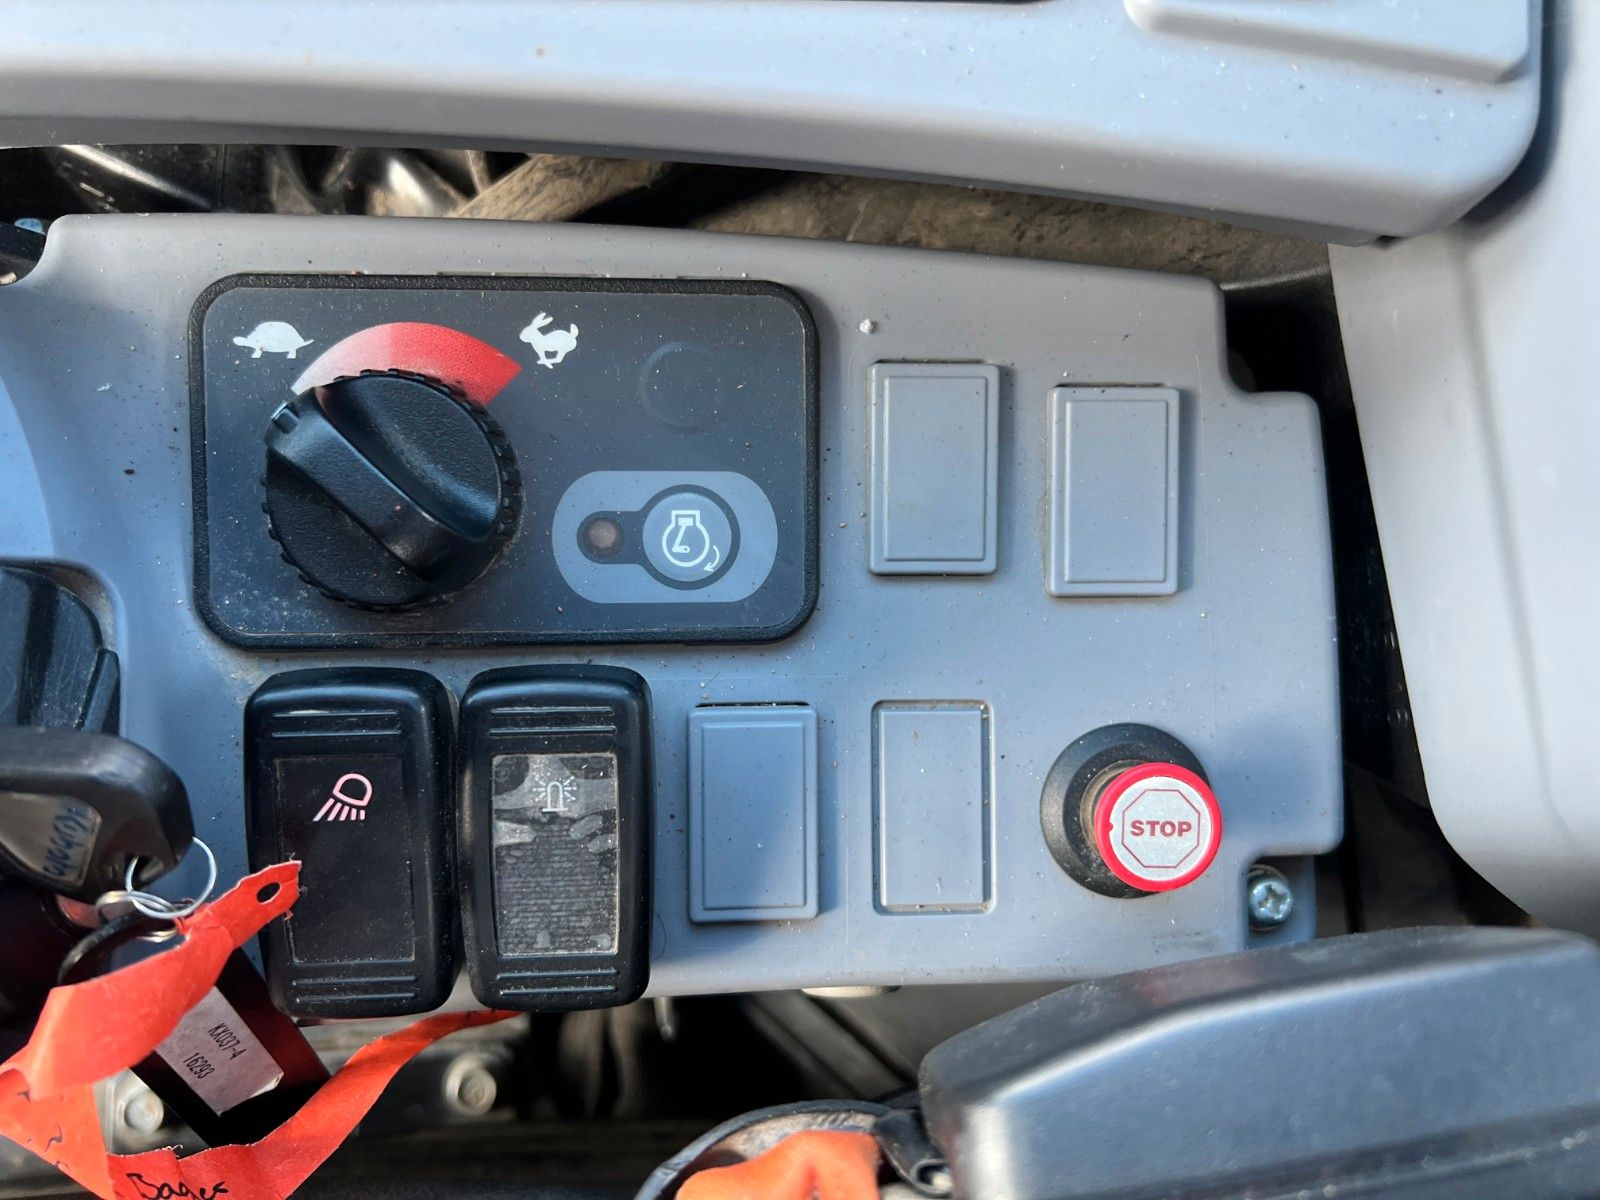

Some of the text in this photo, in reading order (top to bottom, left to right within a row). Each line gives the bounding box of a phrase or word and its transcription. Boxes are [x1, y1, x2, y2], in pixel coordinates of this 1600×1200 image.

[1130, 819, 1192, 837] STOP
[207, 1022, 247, 1061] KX037-4
[182, 1052, 216, 1079] 16293
